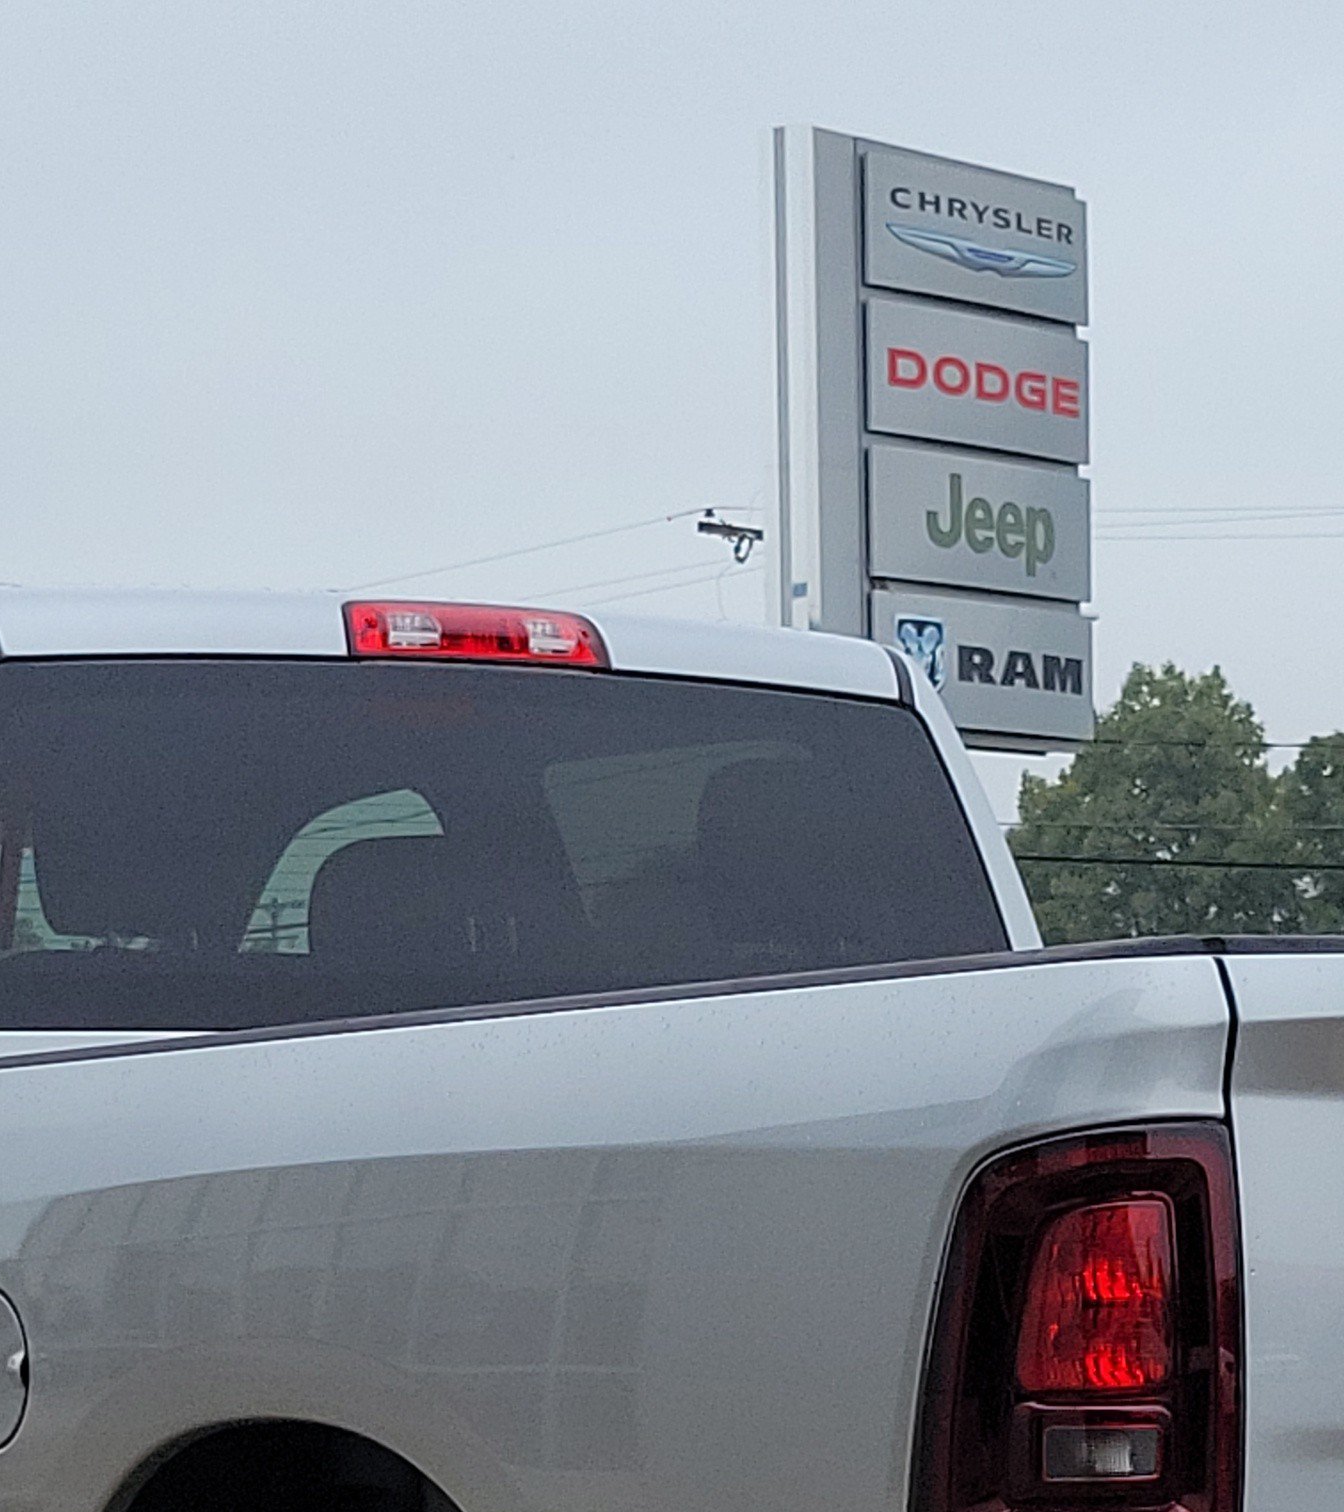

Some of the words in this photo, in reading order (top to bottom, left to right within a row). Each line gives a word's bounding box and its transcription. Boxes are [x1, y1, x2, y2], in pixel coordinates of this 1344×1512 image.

[889, 186, 1074, 246] CHRYSLER
[886, 346, 1081, 419] DODGE
[926, 472, 1055, 577] Jeep
[957, 643, 1084, 696] RAM
